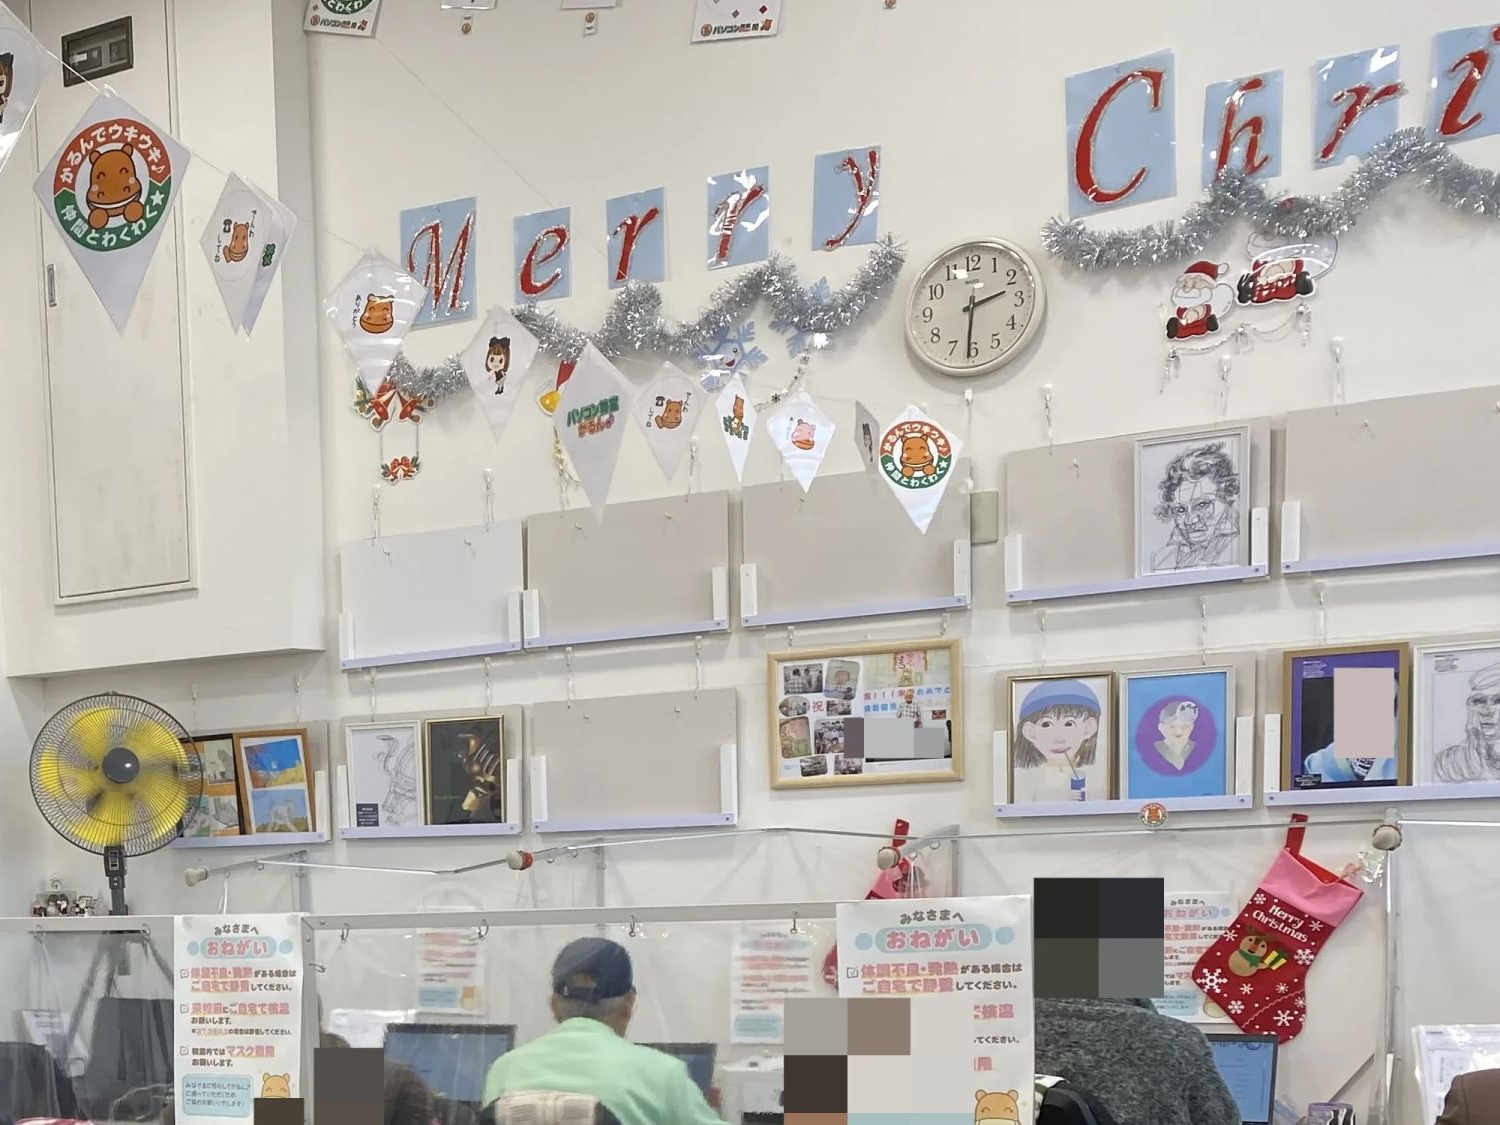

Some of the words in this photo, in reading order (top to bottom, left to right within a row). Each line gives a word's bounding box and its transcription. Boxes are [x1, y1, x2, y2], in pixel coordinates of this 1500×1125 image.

[407, 148, 879, 312] Merry
[965, 254, 981, 272] 12
[991, 257, 997, 273] 1
[1006, 269, 1017, 286] 2
[929, 283, 944, 300] 10
[1014, 290, 1024, 307] 3
[922, 307, 933, 323] 9
[1006, 314, 1017, 330] 4
[930, 327, 941, 343] 8
[990, 332, 1000, 349] 5
[948, 340, 959, 356] 7
[900, 909, 964, 925] みなさまへ
[1269, 905, 1305, 929] Merry
[214, 923, 259, 936] みなさまへ
[1252, 910, 1308, 943] Christmas
[886, 927, 979, 949] おねがい
[208, 940, 268, 955] おねがい
[974, 1036, 1020, 1044] てください。
